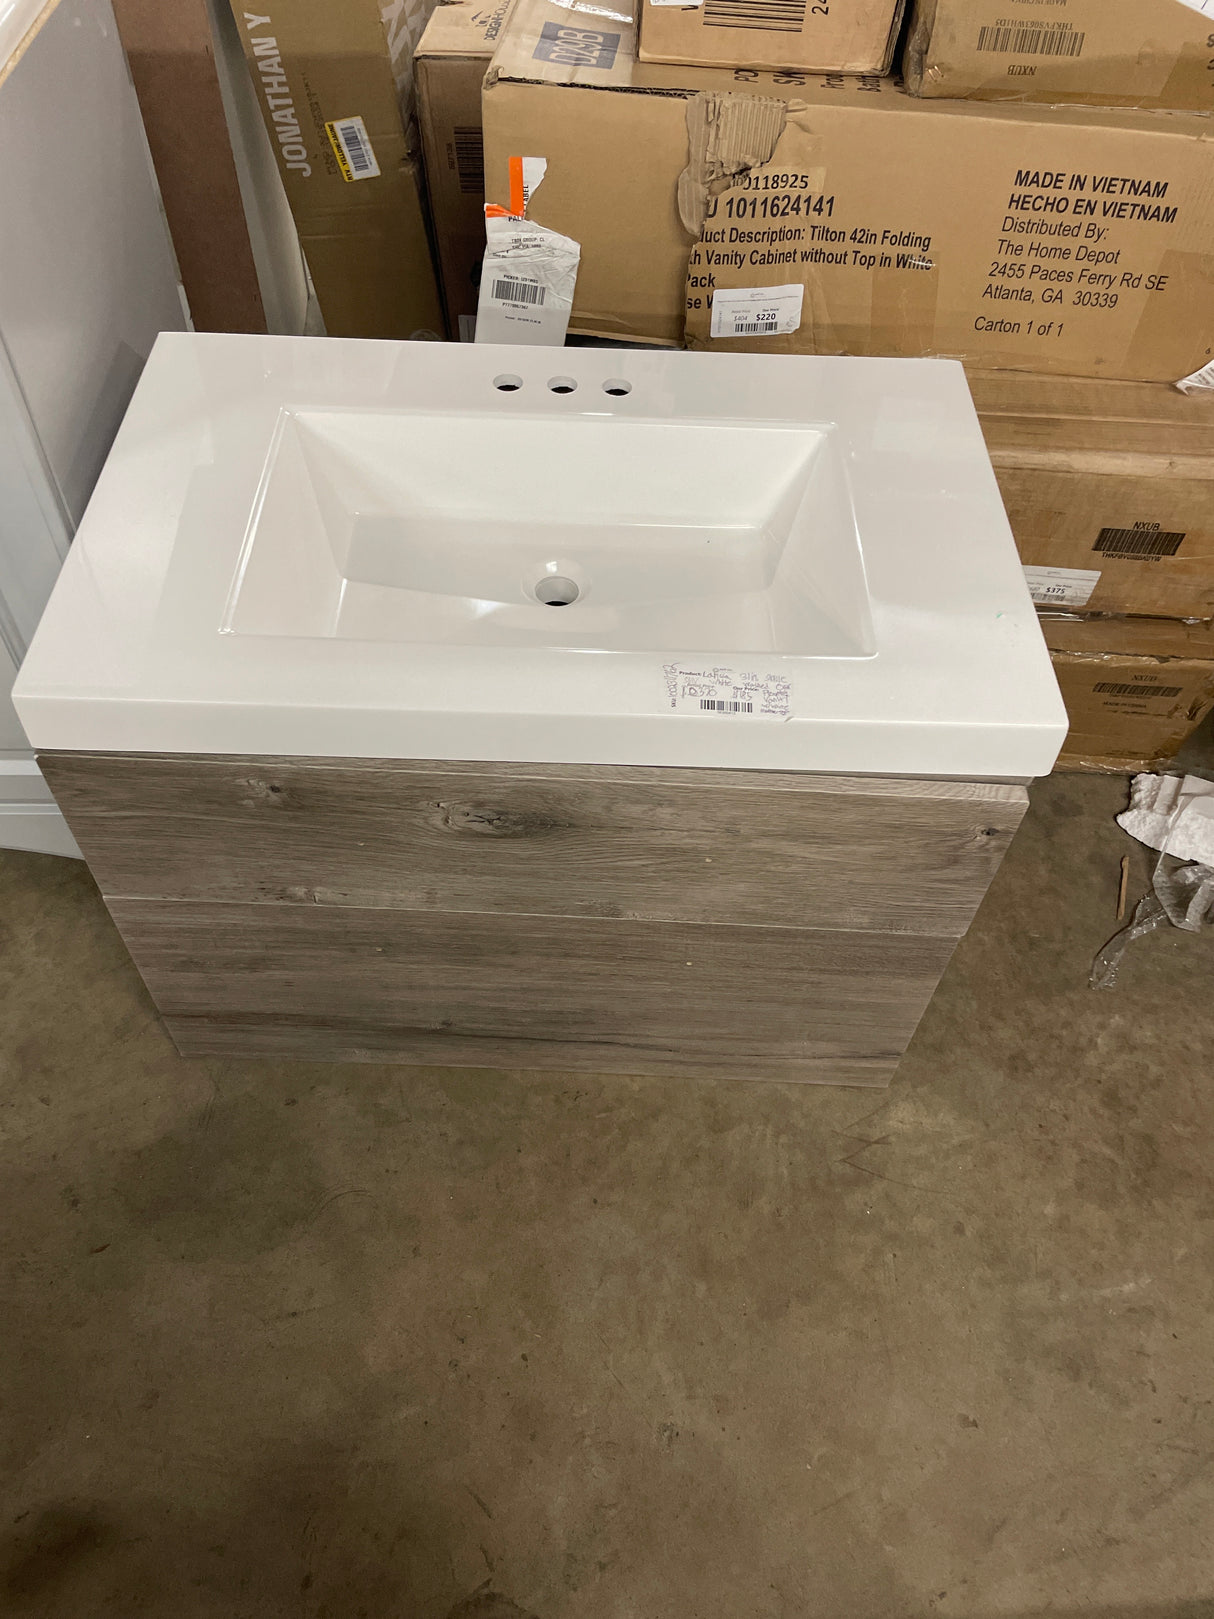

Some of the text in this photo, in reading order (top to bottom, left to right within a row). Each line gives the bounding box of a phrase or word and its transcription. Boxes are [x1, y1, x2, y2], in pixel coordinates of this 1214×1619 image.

[549, 29, 604, 65] D29B
[1007, 64, 1038, 76] NXUB
[243, 12, 312, 178] JONATHAN Y
[1014, 169, 1169, 199] MADE IN VIETNAM
[726, 194, 835, 219] 1011624141
[1008, 193, 1178, 224] HECHO EN VIETNAM
[728, 225, 806, 247] Description:
[810, 225, 846, 243] Tilton
[849, 227, 878, 245] 42in
[881, 230, 932, 252] Folding
[1001, 216, 1110, 243] Distributed By:
[706, 249, 746, 270] Vanity
[749, 248, 798, 266] Cabinet
[800, 248, 848, 265] without
[852, 250, 876, 270] Top
[879, 252, 892, 268] in
[896, 253, 934, 271] White
[998, 239, 1121, 267] The Home Depot
[988, 261, 1170, 292] 2455 Paces Ferry Rd SE
[982, 283, 1119, 309] Atlanta, GA 30339
[756, 313, 776, 321] $220
[974, 316, 1064, 337] Carton 1 of 1
[1133, 521, 1161, 531] NXUB
